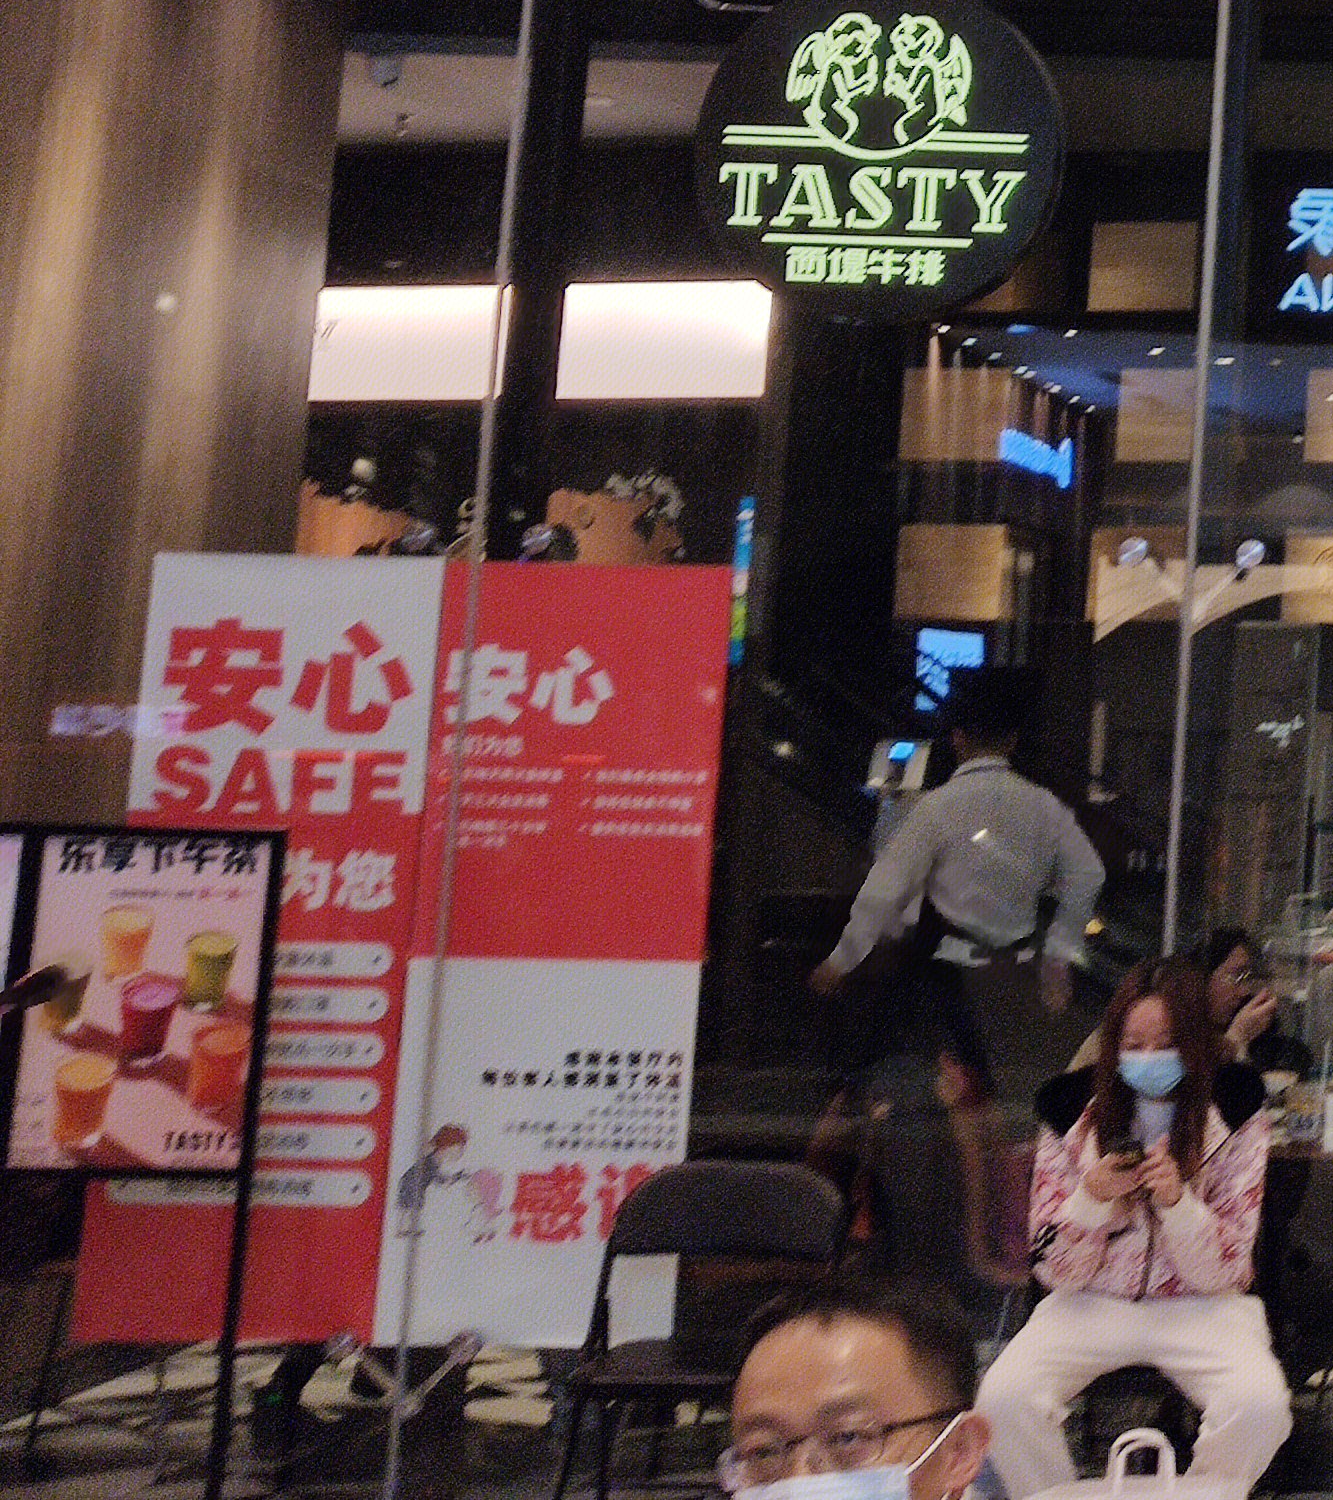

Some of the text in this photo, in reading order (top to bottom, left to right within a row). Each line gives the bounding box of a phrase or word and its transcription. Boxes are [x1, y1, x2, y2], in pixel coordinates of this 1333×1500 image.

[718, 161, 1027, 234] TASTY
[785, 245, 947, 286] 西堤牛排
[163, 617, 412, 735] 安心
[442, 643, 615, 726] 安心
[151, 745, 408, 816] SAFE
